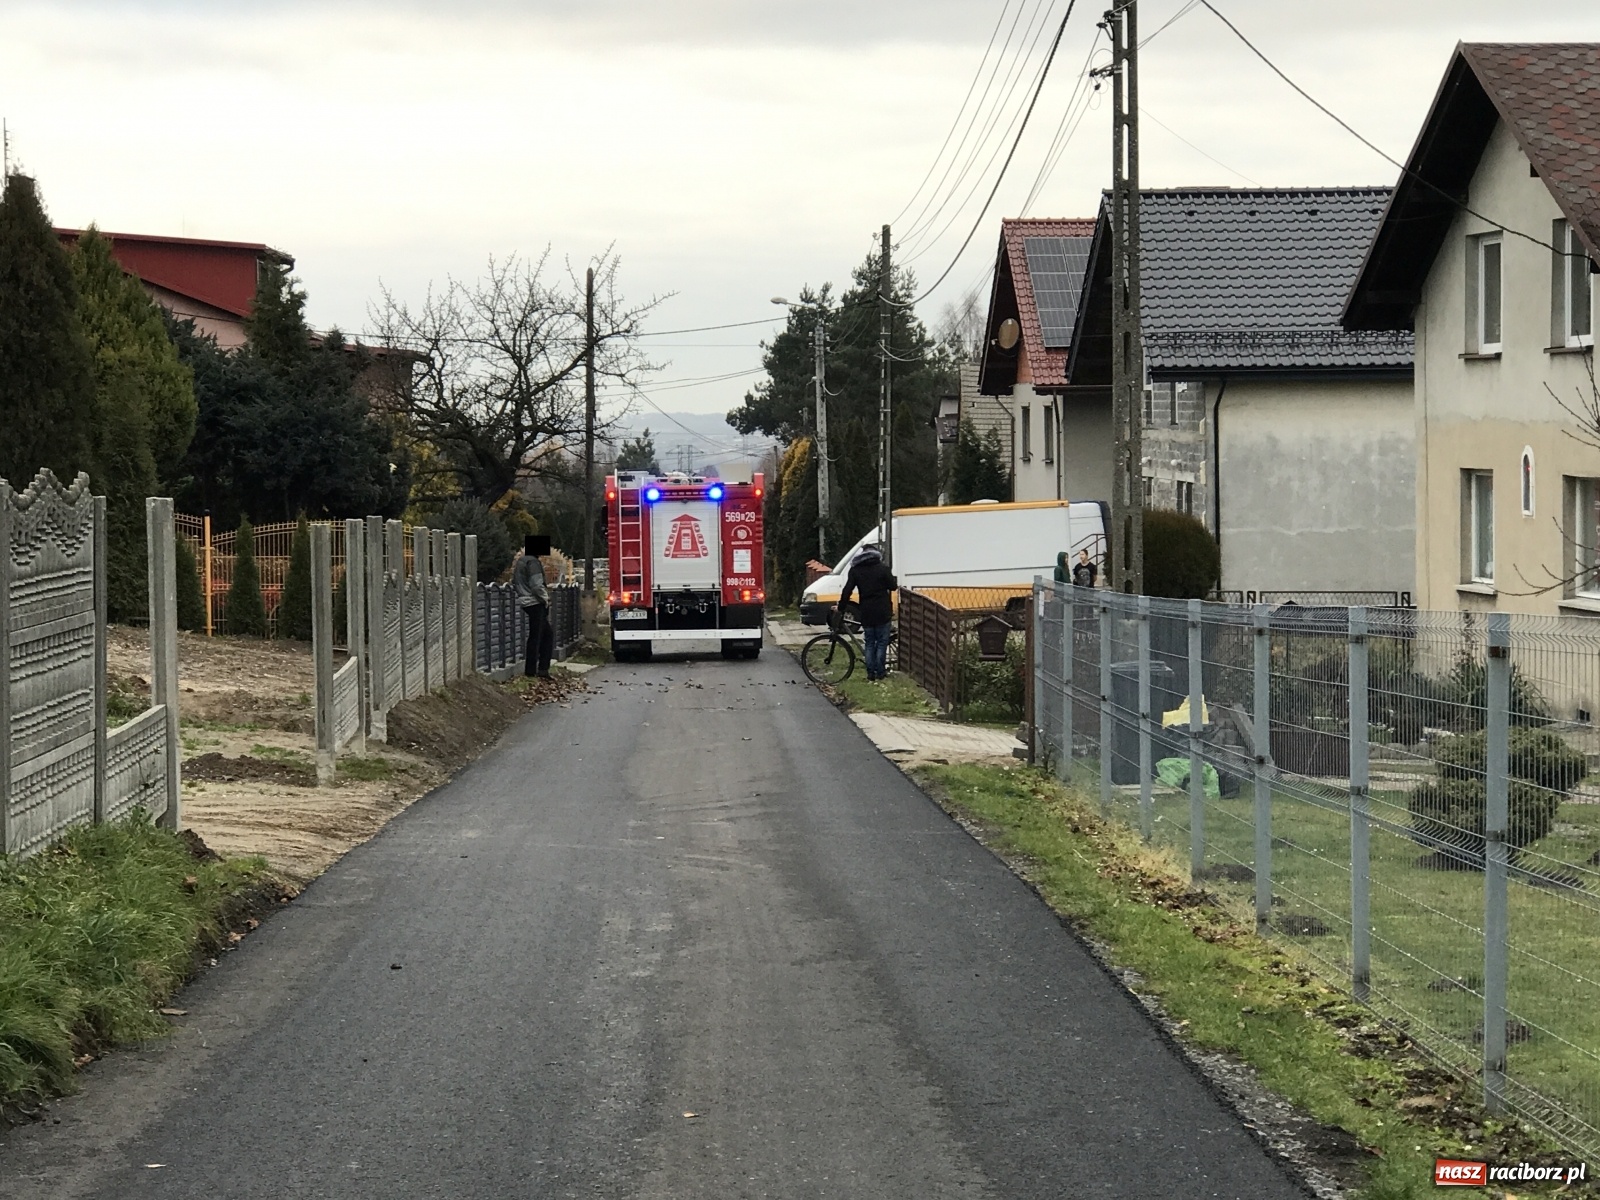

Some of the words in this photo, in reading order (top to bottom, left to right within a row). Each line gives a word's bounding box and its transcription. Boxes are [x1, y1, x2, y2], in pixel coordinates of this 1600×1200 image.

[725, 511, 740, 522] 569
[745, 511, 756, 522] 29
[745, 577, 756, 586] 112
